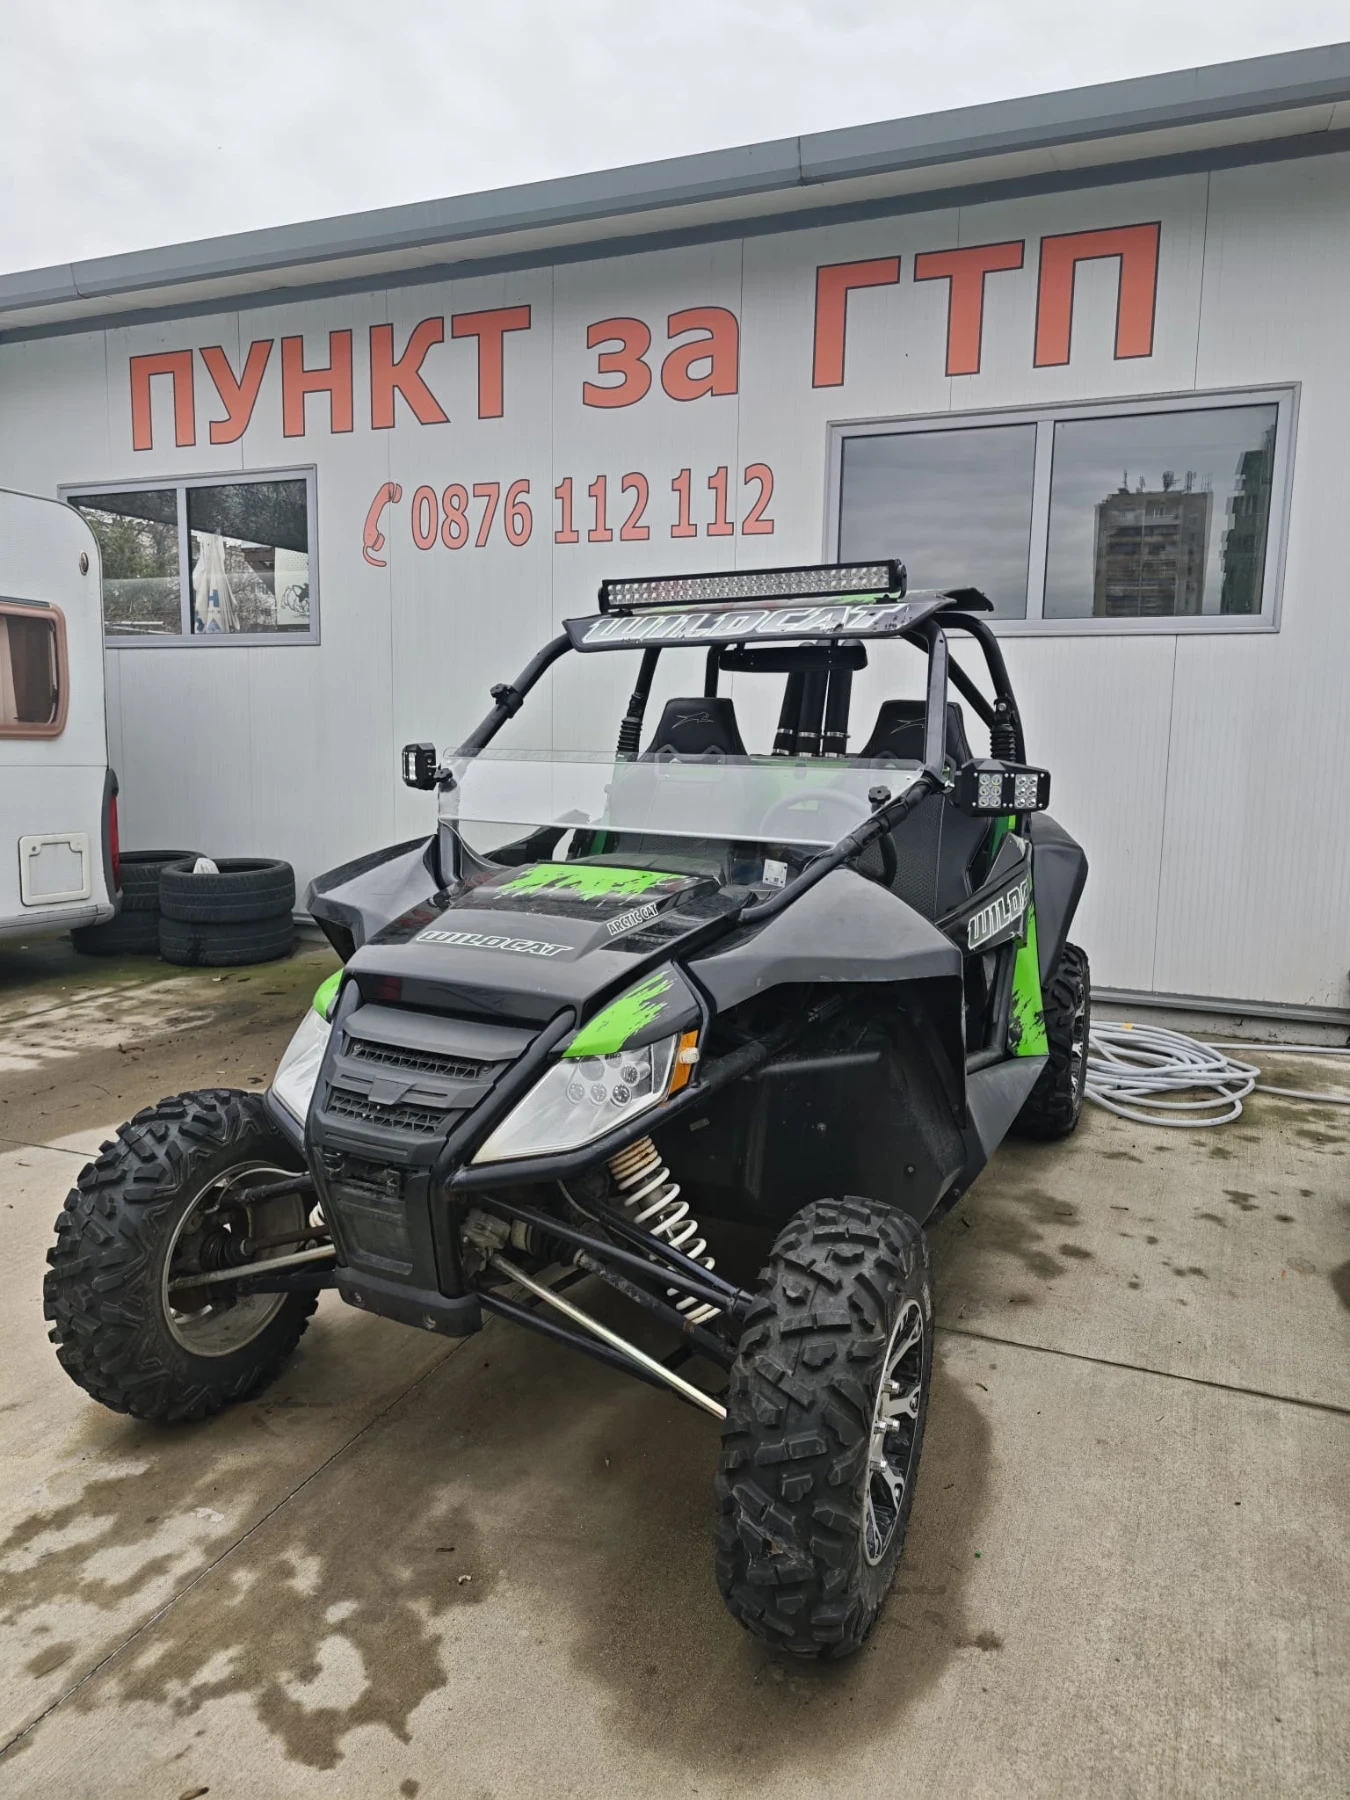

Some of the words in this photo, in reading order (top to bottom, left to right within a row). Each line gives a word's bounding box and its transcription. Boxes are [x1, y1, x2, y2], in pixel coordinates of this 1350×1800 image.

[129, 304, 531, 451] ПУНКТ
[582, 306, 740, 408] за
[812, 222, 1161, 388] ГТП
[411, 479, 532, 550] 0876
[554, 472, 650, 544] 112
[670, 463, 775, 538] 112
[582, 603, 905, 643] WILDCAT
[606, 910, 643, 936] ARCTIC
[640, 902, 659, 920] CAT
[415, 930, 574, 956] WILDCAT
